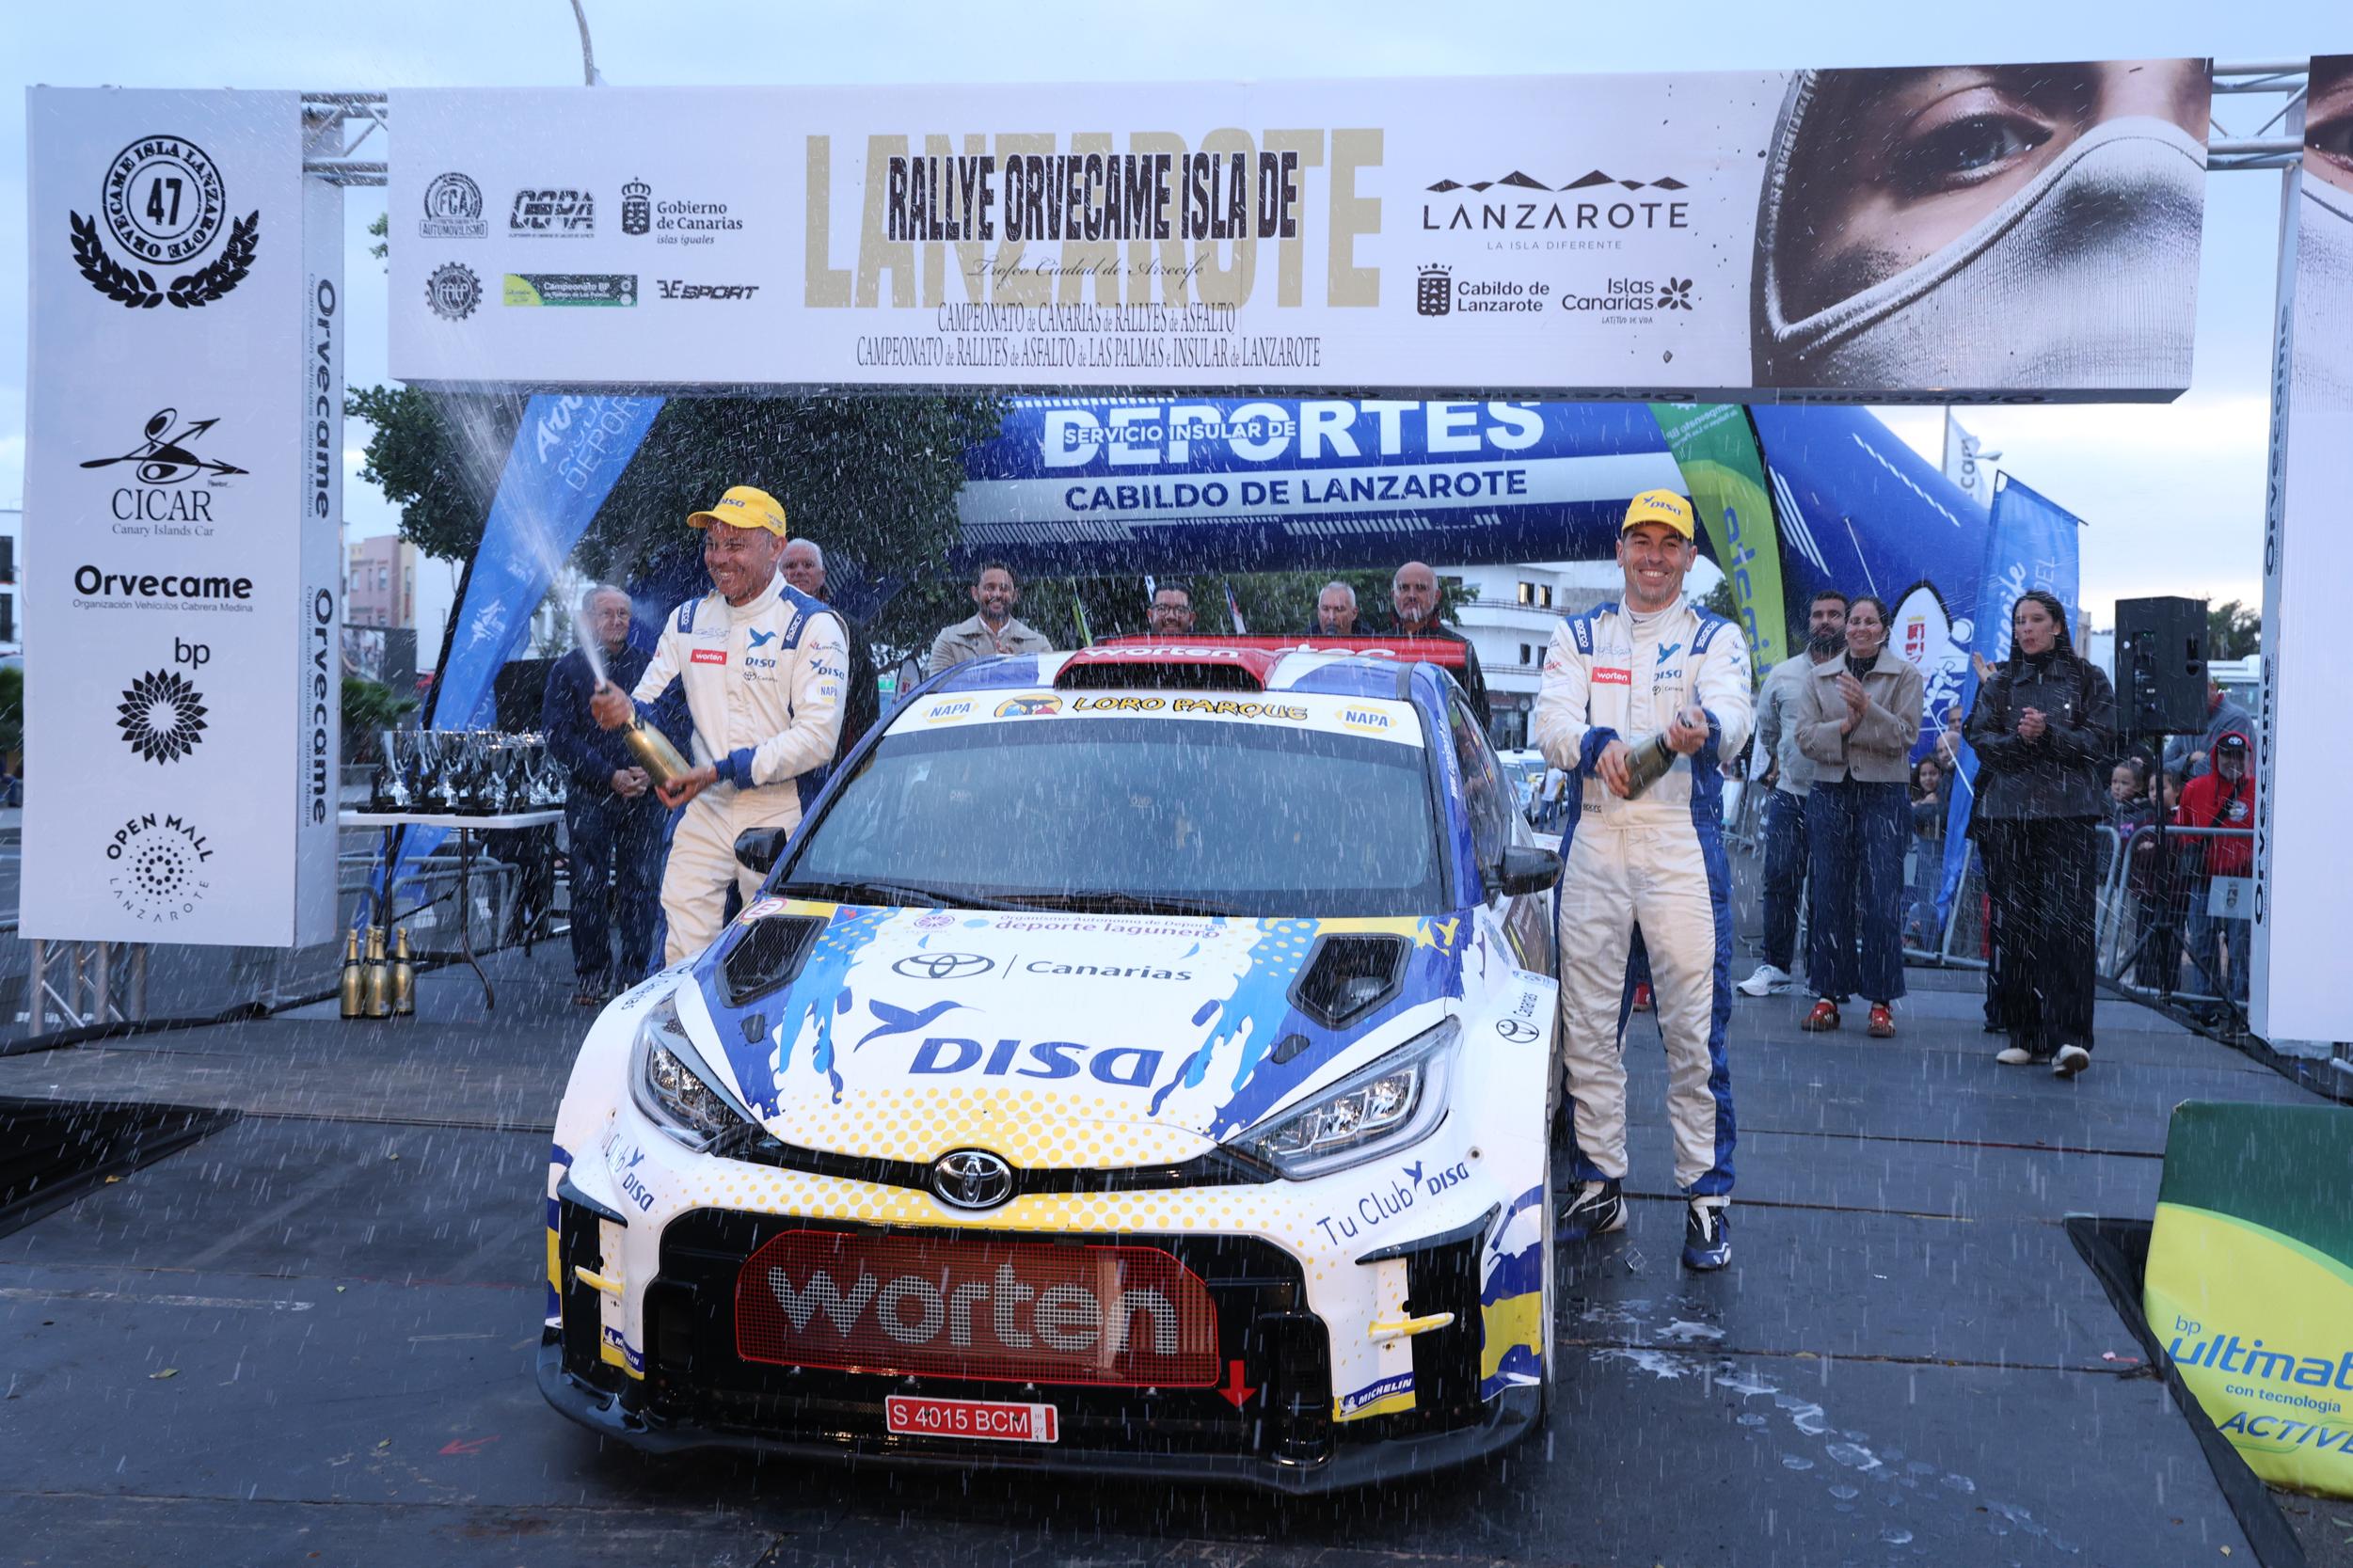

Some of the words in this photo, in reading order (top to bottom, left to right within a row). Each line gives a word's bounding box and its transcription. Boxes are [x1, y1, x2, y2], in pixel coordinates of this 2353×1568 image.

[134, 140, 181, 162] ISLA
[147, 177, 183, 226] 47
[657, 200, 727, 214] Gobierno
[888, 152, 994, 243] RALLYE
[1004, 151, 1171, 242] ORVECAME
[1181, 150, 1248, 241] ISLA
[1257, 150, 1297, 240] DE
[657, 216, 675, 230] de
[676, 216, 743, 230] Canarias
[804, 127, 1385, 311] LANZAROTE
[1423, 202, 1690, 230] LANZAROTE
[657, 233, 678, 245] islas
[680, 233, 715, 245] iguales
[1487, 241, 1503, 250] LA
[1510, 241, 1540, 250] ISLA
[1547, 240, 1623, 250] DIFERENTE
[966, 253, 1030, 290] Trofeo
[1035, 256, 1105, 277] Ciudad
[1102, 257, 1121, 277] de
[1128, 252, 1210, 290] Arrecife
[598, 283, 611, 292] BP
[1457, 280, 1523, 296] Cabildo
[1529, 280, 1550, 296] de
[1607, 277, 1654, 294] Islas
[938, 301, 1025, 333] CAMPEONATO
[1027, 310, 1037, 332] de
[1039, 301, 1102, 333] CANARIAS
[1103, 310, 1113, 332] de
[1115, 301, 1168, 333] RALLYES
[1169, 310, 1179, 332] de
[1181, 301, 1235, 333] ASFALTO
[1457, 298, 1544, 312] Lanzarote
[1639, 316, 1653, 325] VIDA
[857, 336, 944, 368] CAMPEONATO
[946, 344, 955, 367] de
[957, 337, 1009, 368] RALLYES
[1010, 344, 1019, 367] de
[1021, 337, 1075, 368] ASFALTO
[1078, 344, 1088, 367] de
[1089, 337, 1113, 368] LAS
[1115, 337, 1165, 368] PALMAS
[1166, 350, 1171, 368] e
[1173, 337, 1229, 368] INSULAR
[1231, 345, 1240, 368] de
[1242, 337, 1321, 368] LANZAROTE
[316, 278, 336, 519] Orvecame
[1044, 401, 1545, 468] DEPORTES
[1063, 424, 1164, 446] SERVICIO
[1168, 421, 1263, 441] INSULAR
[1267, 420, 1296, 438] DE
[2266, 305, 2288, 577] Orvecame
[112, 487, 214, 522] CICAR
[1064, 481, 1228, 513] CABILDO
[1241, 480, 1288, 506] DE
[1301, 470, 1528, 502] LANZAROTE
[112, 524, 151, 537] Canary
[154, 524, 192, 537] Islands
[195, 525, 215, 537] Car
[74, 564, 253, 599] Orvecame
[72, 599, 133, 610] Organización
[135, 600, 179, 611] Vehículos
[182, 602, 218, 611] Cabrera
[220, 603, 253, 612] Medina
[175, 637, 211, 671] bp
[695, 652, 723, 662] worten
[1085, 646, 1239, 658] worten
[1597, 672, 1628, 682] worten
[312, 588, 333, 826] Orvecame
[930, 701, 971, 719] NAPA
[1073, 696, 1168, 713] LORO
[1173, 698, 1308, 721] PARQUE
[1345, 710, 1390, 728] NAPA
[2254, 656, 2271, 925] Orvecame
[106, 813, 157, 860] OPEN
[165, 814, 214, 863] MALL
[109, 877, 209, 923] LANZAROTE
[995, 916, 1097, 932] deporte
[1104, 923, 1220, 939] lagunero
[1025, 960, 1193, 981] Canarias
[1316, 1216, 1359, 1246] Tu
[1359, 1180, 1414, 1225] Club
[768, 1263, 1178, 1356] worten
[2175, 1315, 2202, 1337] bp
[1358, 1377, 1412, 1406] MICHELIN
[2225, 1384, 2254, 1398] con
[893, 1404, 909, 1426] S
[914, 1405, 968, 1431] 4015
[976, 1409, 1028, 1433] BCM
